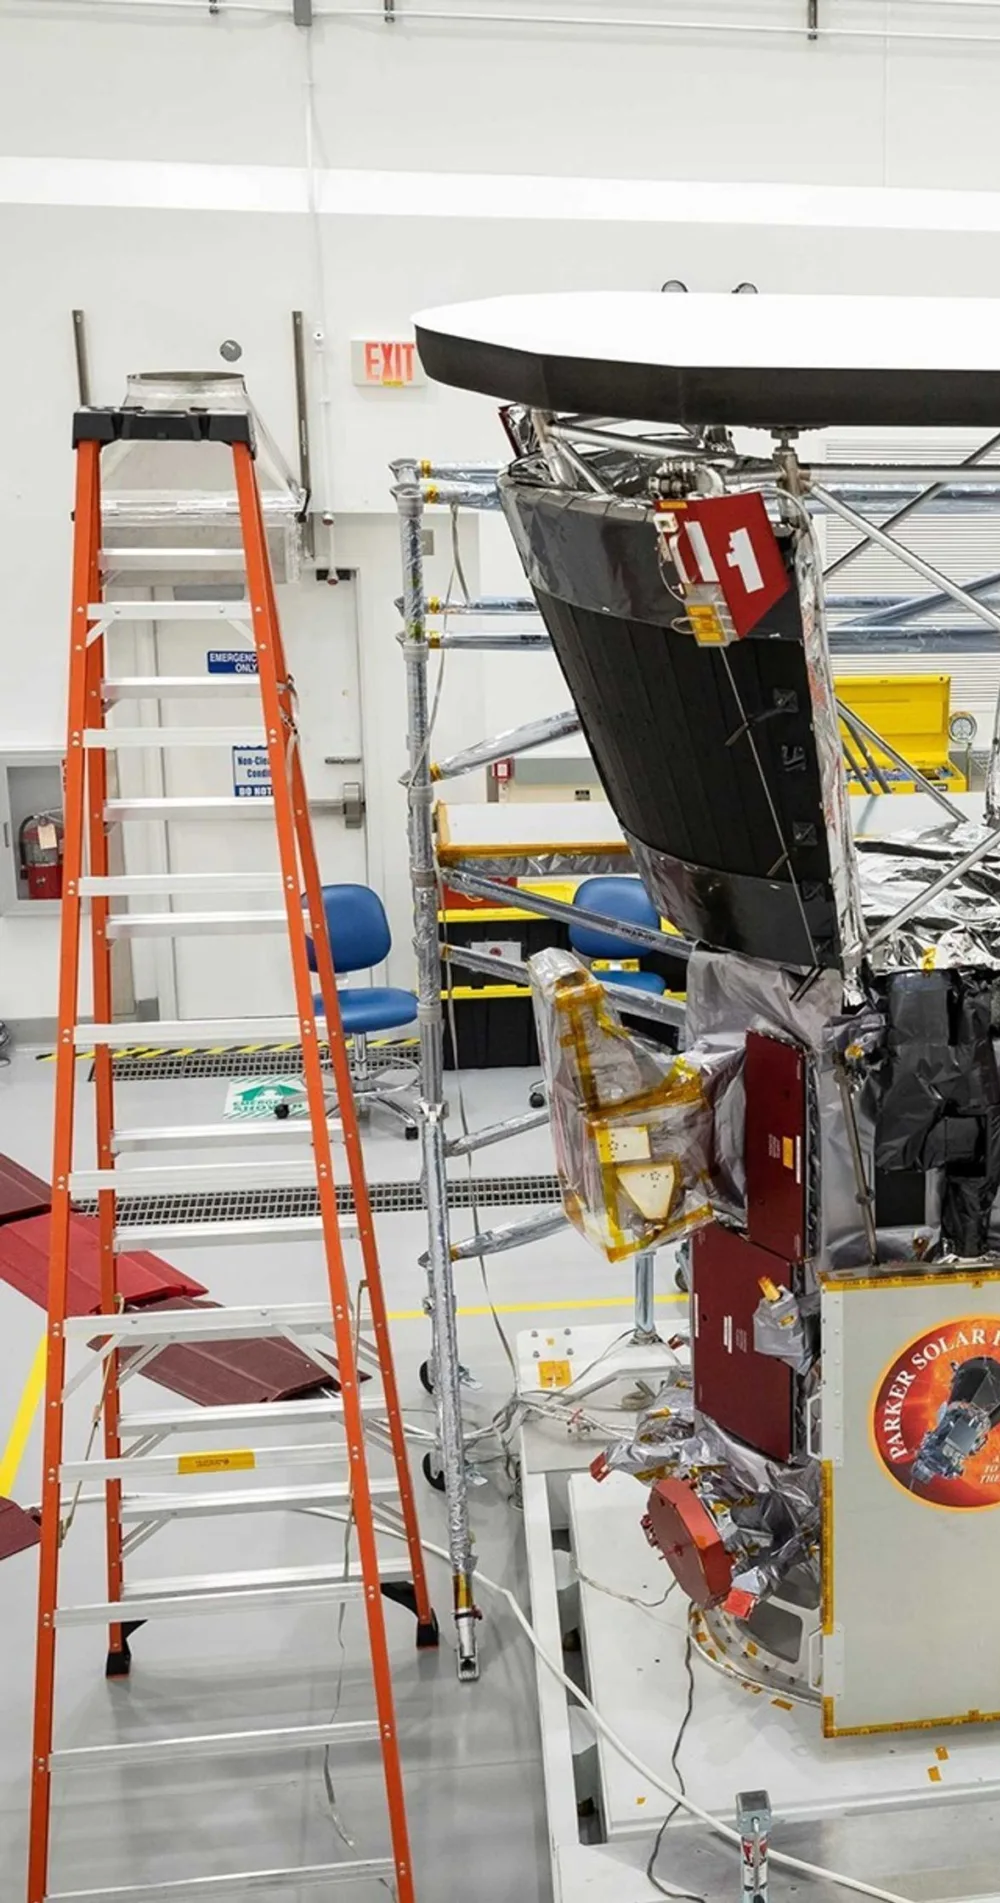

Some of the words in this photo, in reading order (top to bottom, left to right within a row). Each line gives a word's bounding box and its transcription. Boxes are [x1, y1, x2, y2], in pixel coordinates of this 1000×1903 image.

[364, 343, 415, 381] EXIT
[209, 653, 258, 662] EMERGENC
[235, 663, 257, 672] ONLY
[239, 787, 252, 796] DO
[883, 1370, 917, 1460] PARKER
[911, 1328, 986, 1370] SOLAR
[984, 1464, 999, 1474] TO
[980, 1473, 1000, 1484] THE
